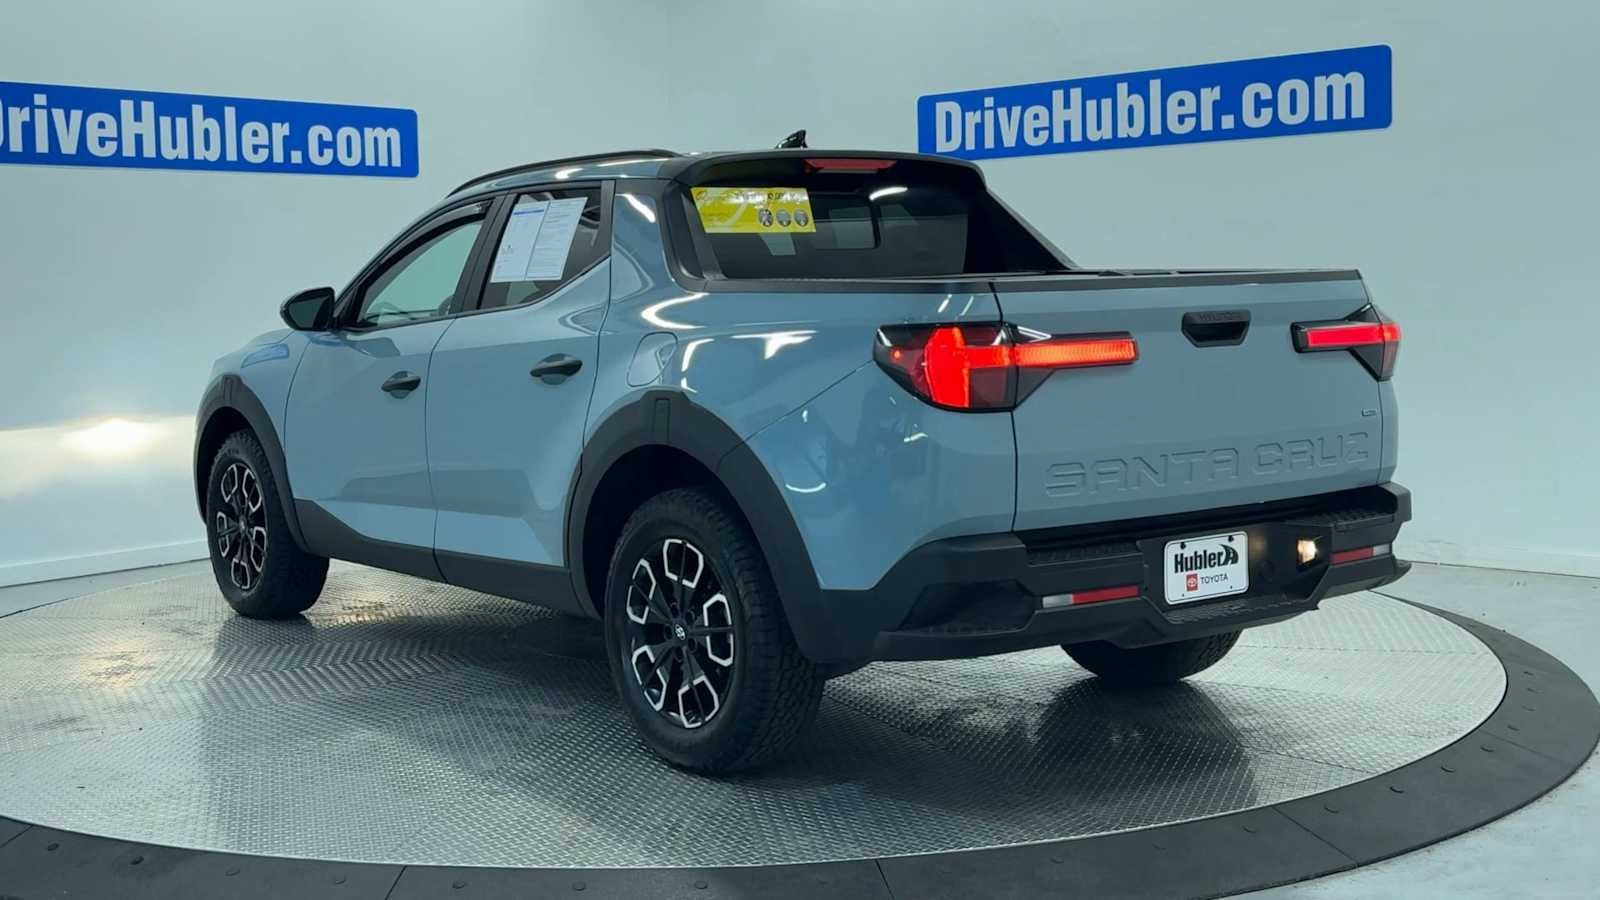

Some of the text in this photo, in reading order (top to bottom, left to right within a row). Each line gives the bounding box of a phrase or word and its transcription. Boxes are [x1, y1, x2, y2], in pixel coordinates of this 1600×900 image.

[0, 93, 401, 168] riveHubler.com
[935, 70, 1366, 153] DriveHubler.com
[1046, 431, 1370, 497] SANTA CRUZ
[1174, 549, 1224, 573] Hubler
[1201, 573, 1228, 584] TOYOTA
